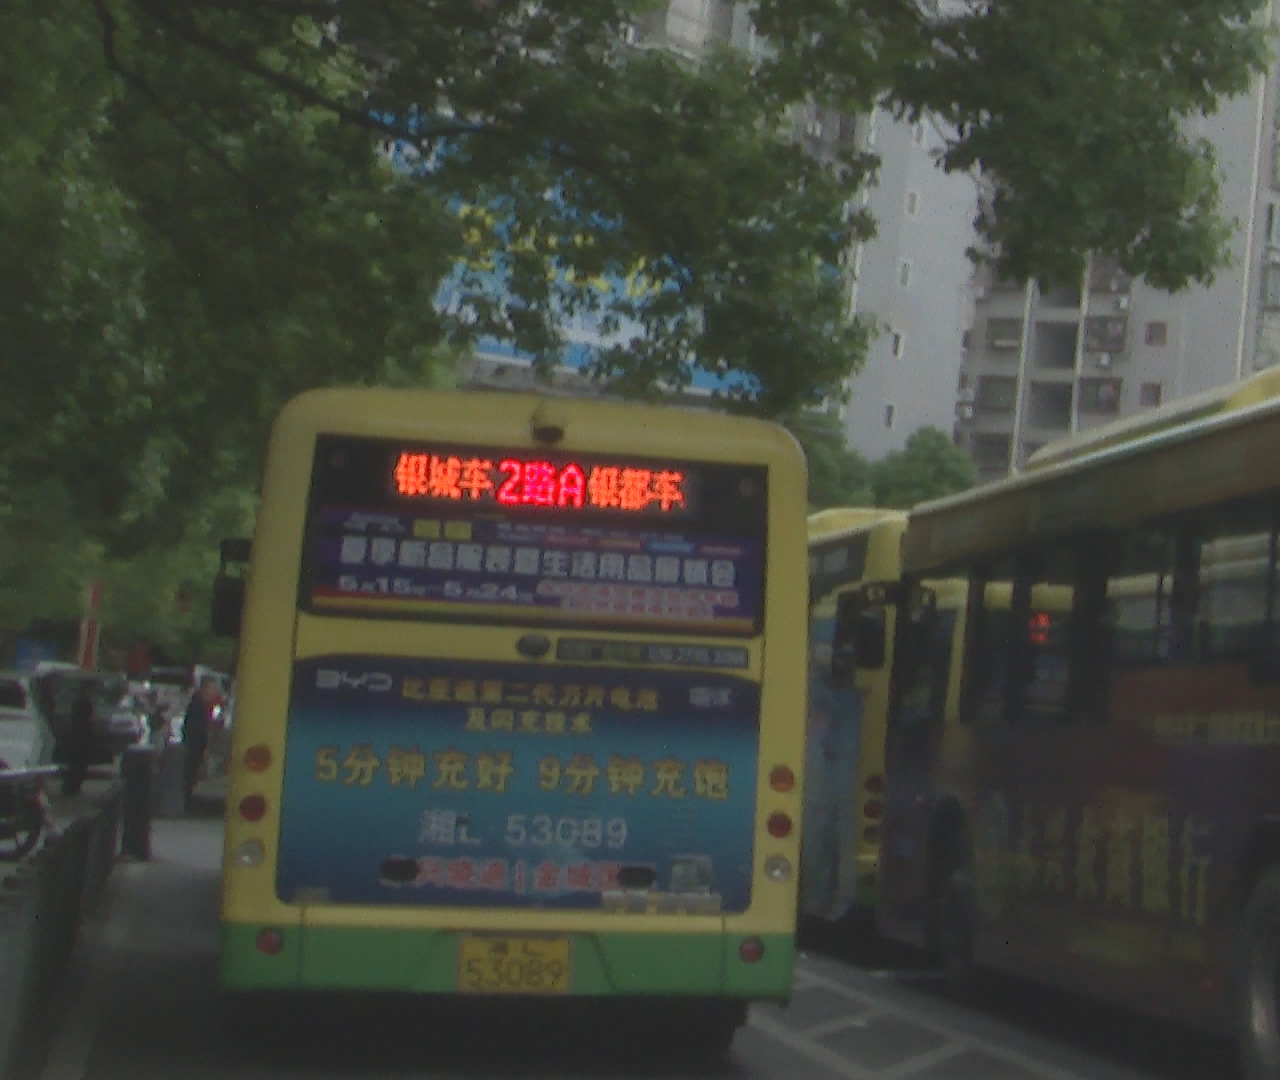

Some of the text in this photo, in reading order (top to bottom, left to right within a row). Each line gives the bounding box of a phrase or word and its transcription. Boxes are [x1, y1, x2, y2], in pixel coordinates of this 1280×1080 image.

[315, 744, 514, 792] 5分钟充好
[503, 813, 629, 849] 53089
